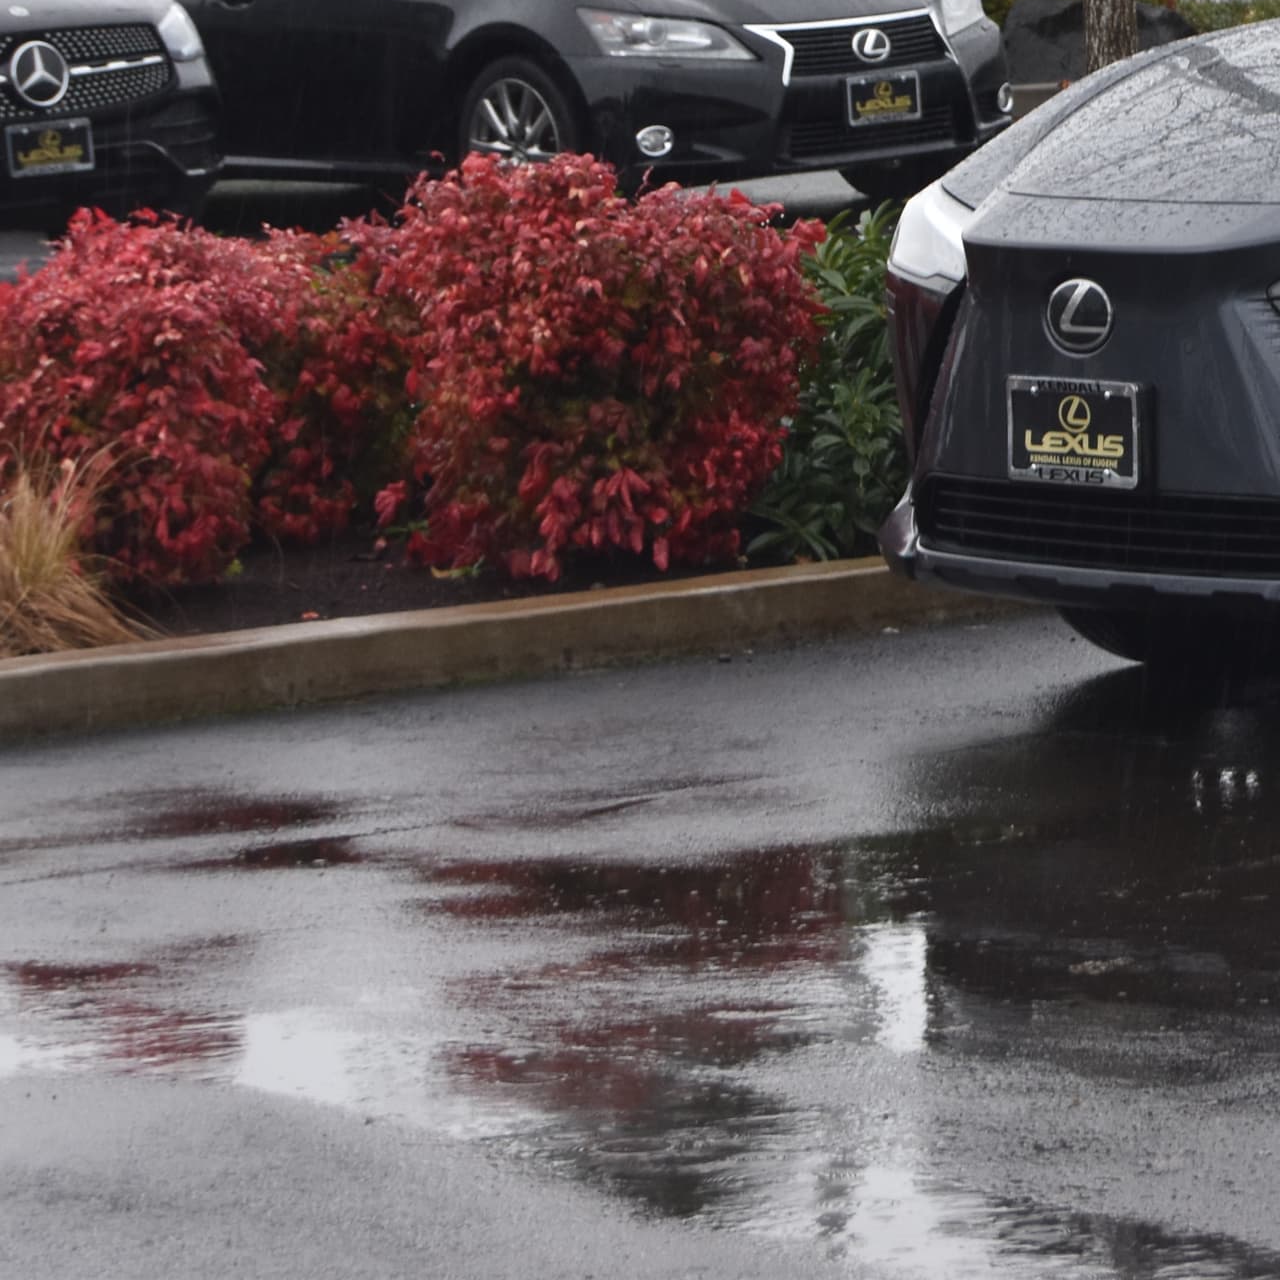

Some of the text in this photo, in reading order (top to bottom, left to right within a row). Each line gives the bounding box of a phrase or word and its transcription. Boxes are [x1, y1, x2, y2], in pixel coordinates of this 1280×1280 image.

[1025, 429, 1124, 458] LEXUS
[1030, 453, 1118, 469] KENDALL LEXUS OF EUGENE
[1036, 468, 1104, 484] LEXUS
